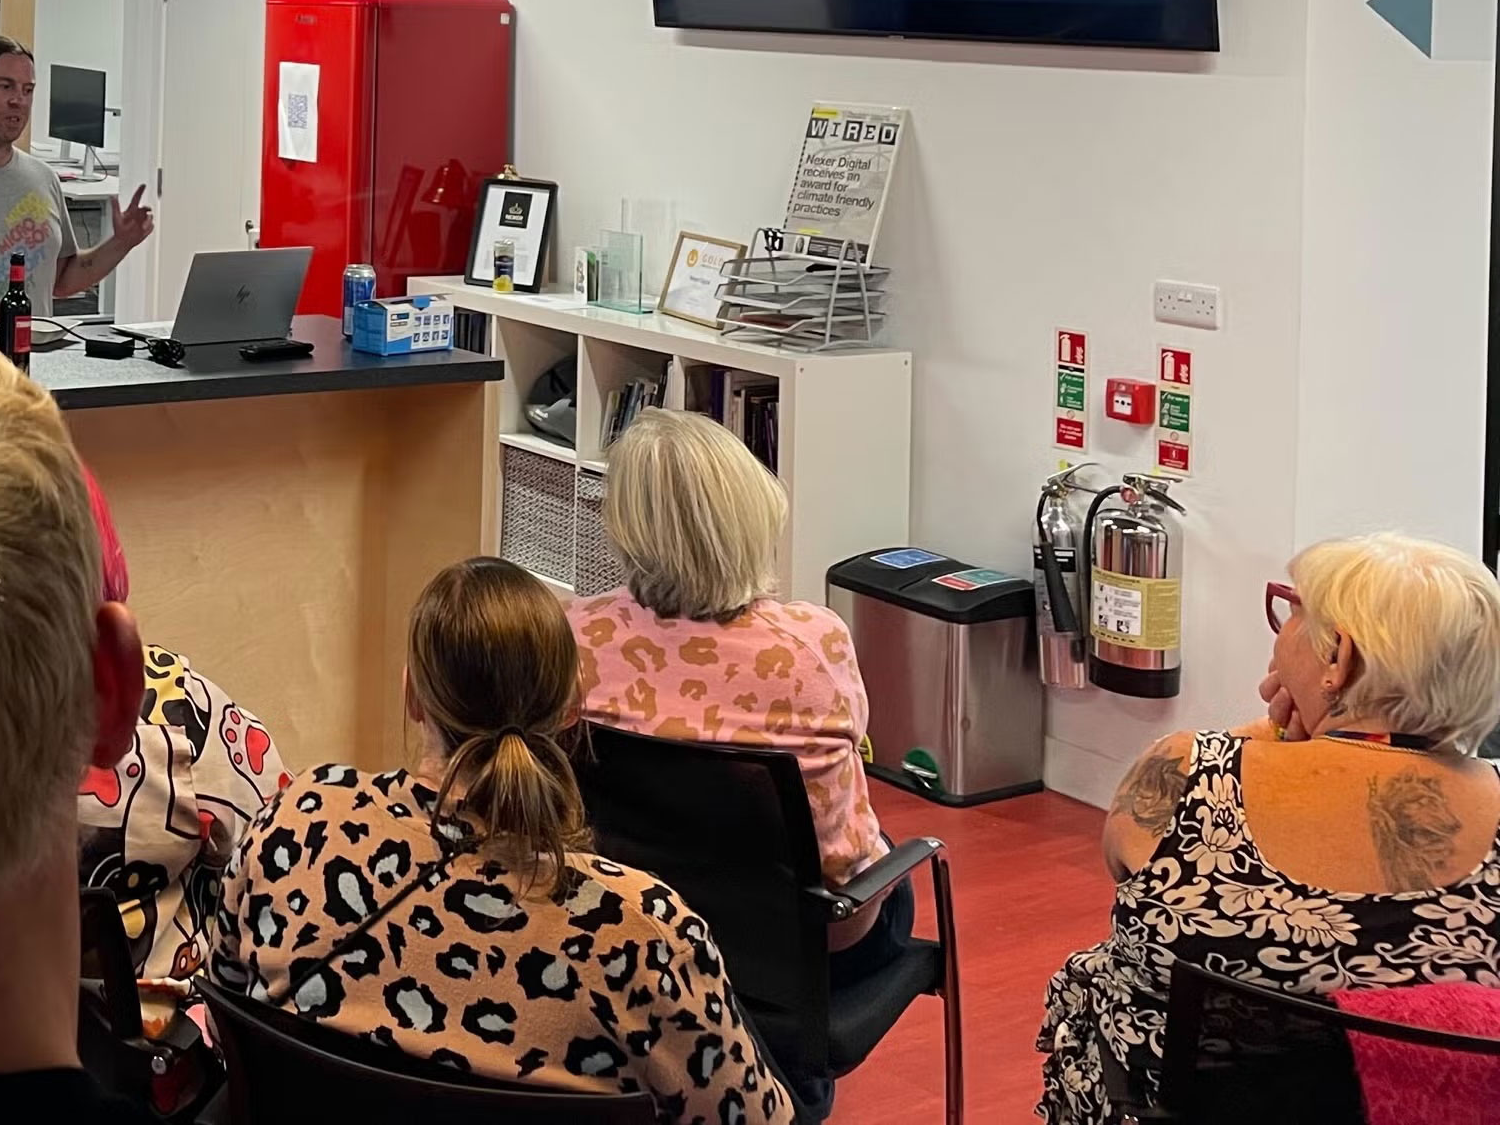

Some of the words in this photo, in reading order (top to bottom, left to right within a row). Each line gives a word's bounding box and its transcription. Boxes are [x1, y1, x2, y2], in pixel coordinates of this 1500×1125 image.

[807, 118, 899, 145] WIRED
[805, 154, 836, 167] Nexer
[838, 157, 871, 172] Digital
[803, 167, 845, 180] receives
[847, 171, 860, 182] an
[800, 179, 831, 191] award
[833, 181, 850, 192] for
[797, 190, 833, 204] climate
[835, 193, 875, 211] friendly
[793, 203, 841, 216] practices
